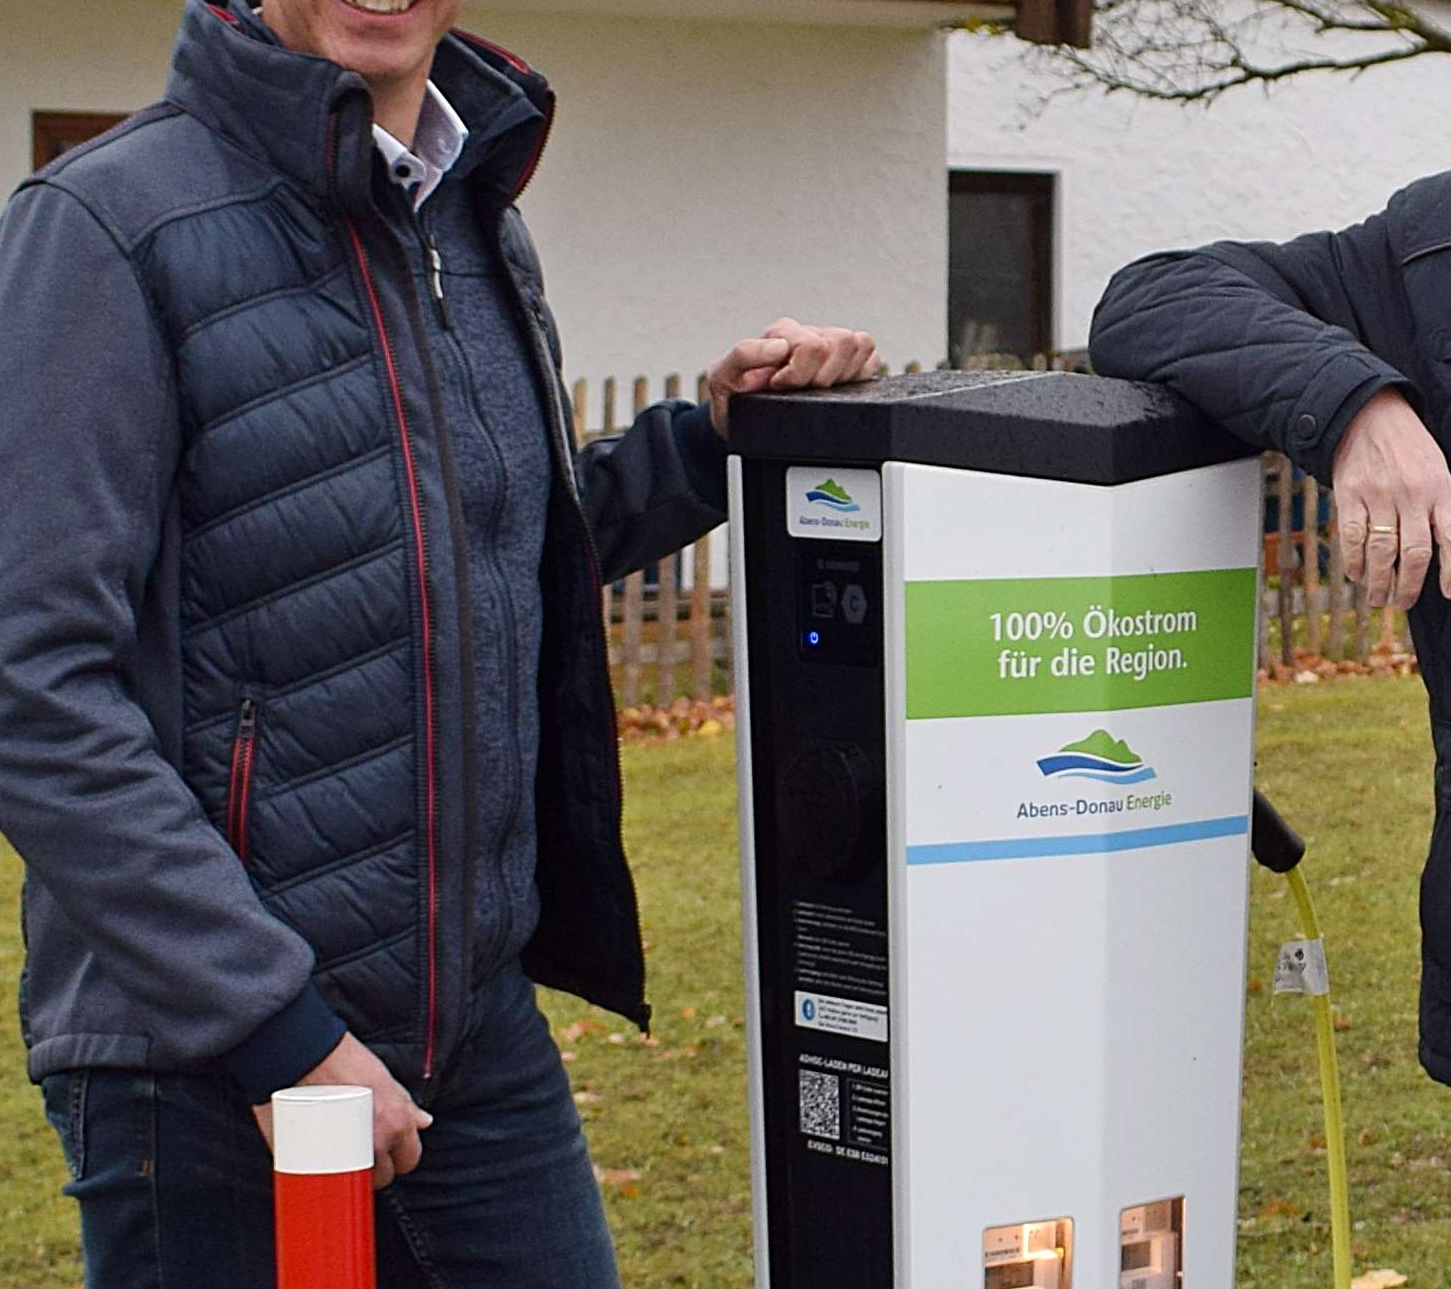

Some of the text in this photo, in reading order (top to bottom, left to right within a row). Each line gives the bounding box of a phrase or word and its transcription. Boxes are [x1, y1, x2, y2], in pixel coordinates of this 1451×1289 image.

[990, 604, 1197, 641] 100% Ökostrom
[998, 643, 1188, 681] für die Region.
[1016, 790, 1172, 819] Abens-Donau Energie
